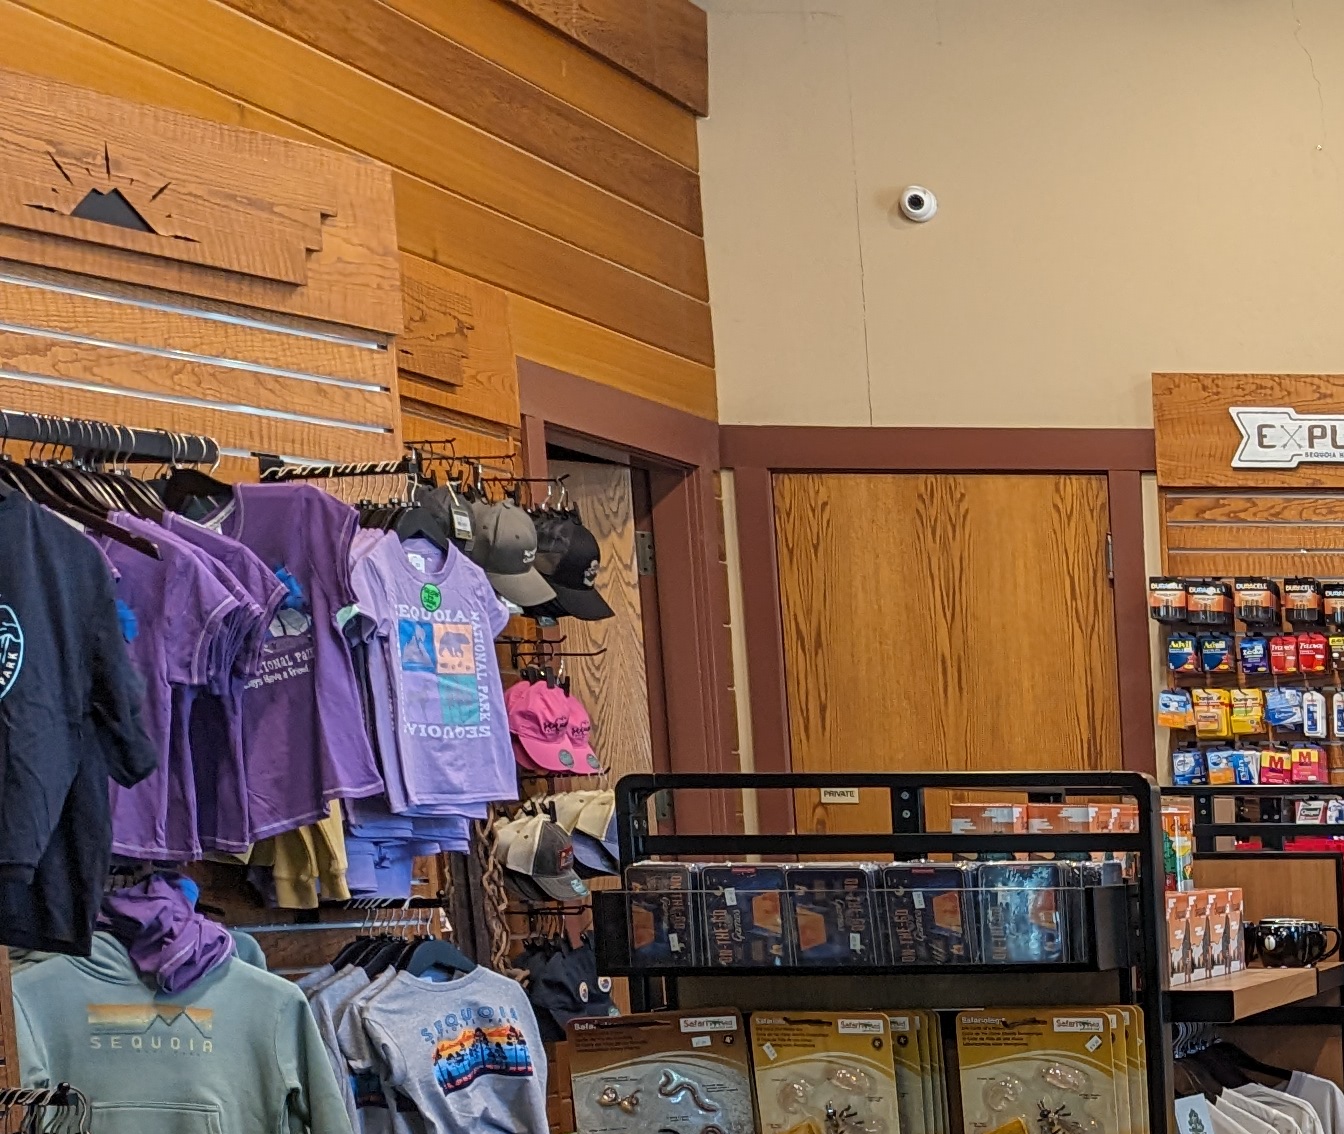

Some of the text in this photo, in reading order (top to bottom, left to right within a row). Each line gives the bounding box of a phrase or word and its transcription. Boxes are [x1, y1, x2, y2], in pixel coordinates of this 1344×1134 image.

[470, 611, 488, 681] NATIONAL
[477, 685, 491, 722] PARK
[823, 789, 855, 798] PRIVATE
[712, 908, 734, 965] ON-THE-GO
[90, 1036, 213, 1053] SEQUOIA
